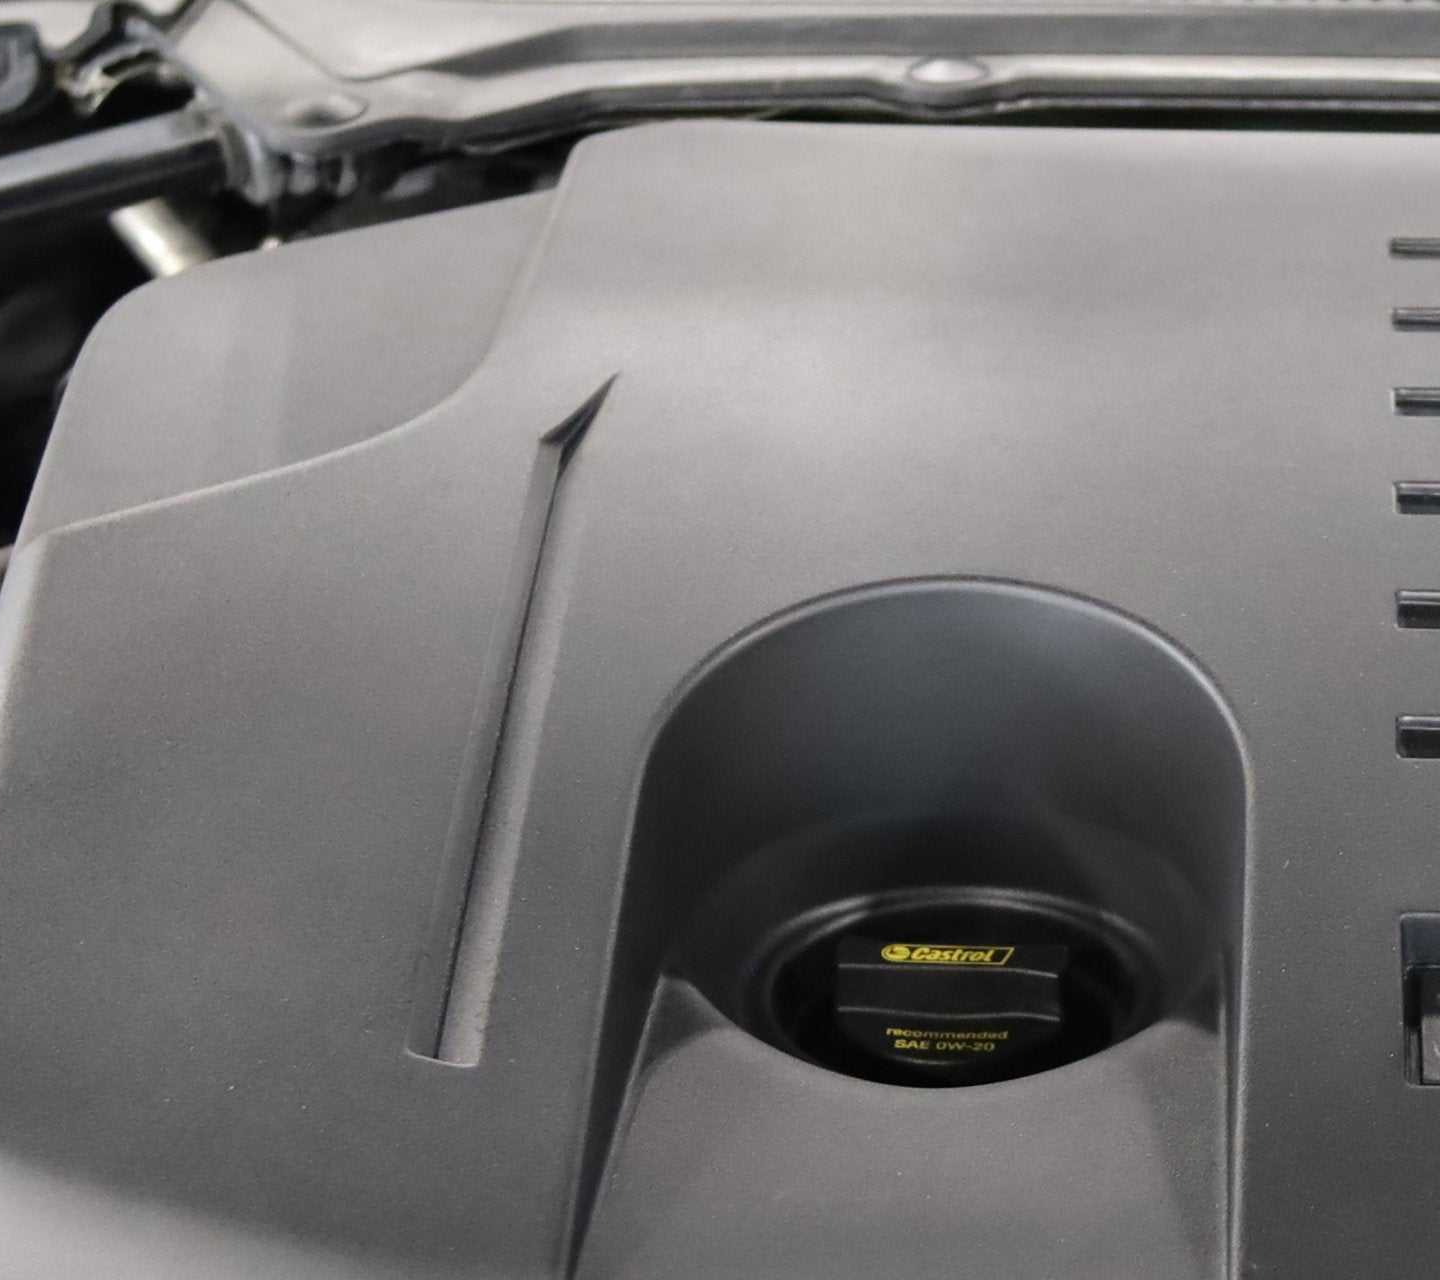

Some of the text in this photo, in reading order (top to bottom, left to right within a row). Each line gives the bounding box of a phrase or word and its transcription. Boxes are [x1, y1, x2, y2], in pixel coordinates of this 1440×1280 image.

[911, 947, 995, 962] Castrol
[886, 1028, 1008, 1039] recommended
[894, 1039, 997, 1052] SAE 0W-20
